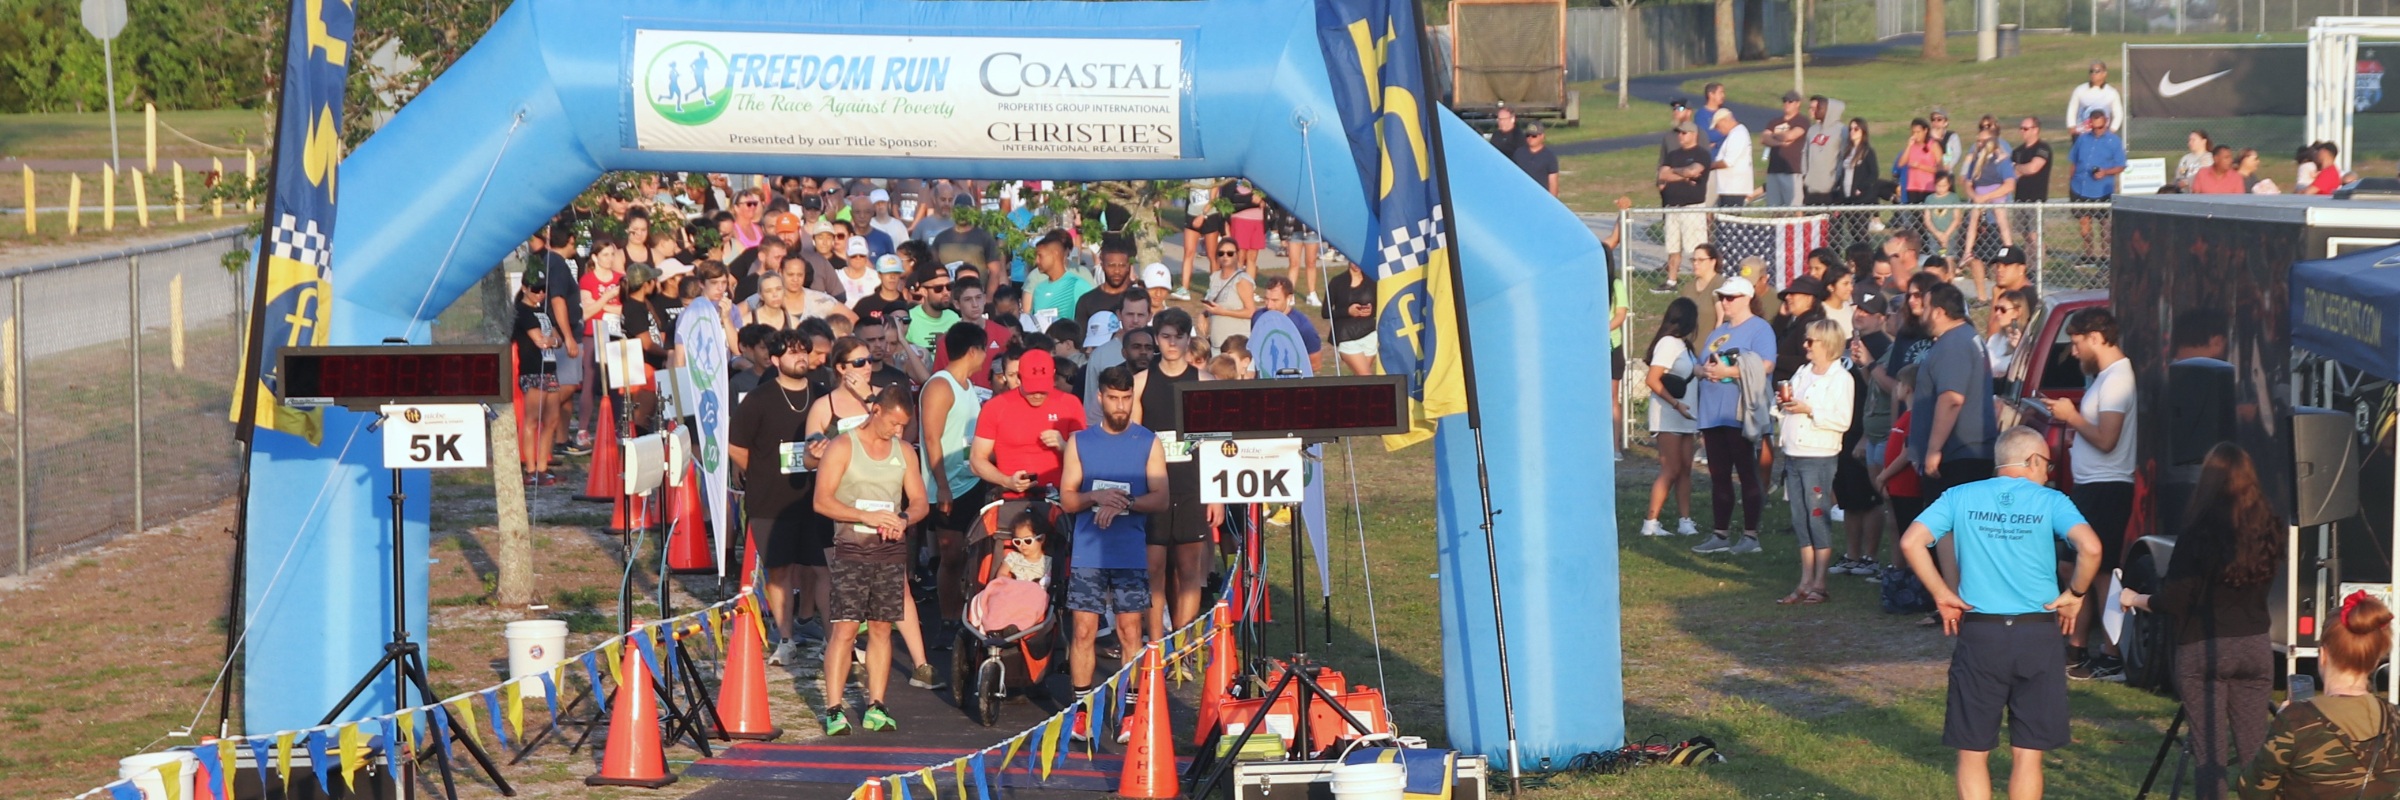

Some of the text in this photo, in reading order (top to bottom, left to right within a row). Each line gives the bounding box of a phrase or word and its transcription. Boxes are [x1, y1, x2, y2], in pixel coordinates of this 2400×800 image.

[725, 53, 951, 93] FREEDOM RUN
[734, 93, 955, 118] The Race Against Poverty
[997, 102, 1171, 114] PROPERTIES GROUP INTERNATIONAL
[729, 133, 938, 149] Presented by our Title Sponsor:
[987, 122, 1173, 144] CHRISTIE'S
[1002, 143, 1160, 154] INTERNATIONAL REAL ESTATE
[409, 434, 463, 462] 5K
[1222, 442, 1237, 456] fit
[1212, 469, 1290, 497] 10K
[1968, 510, 2044, 524] TIMING CREW
